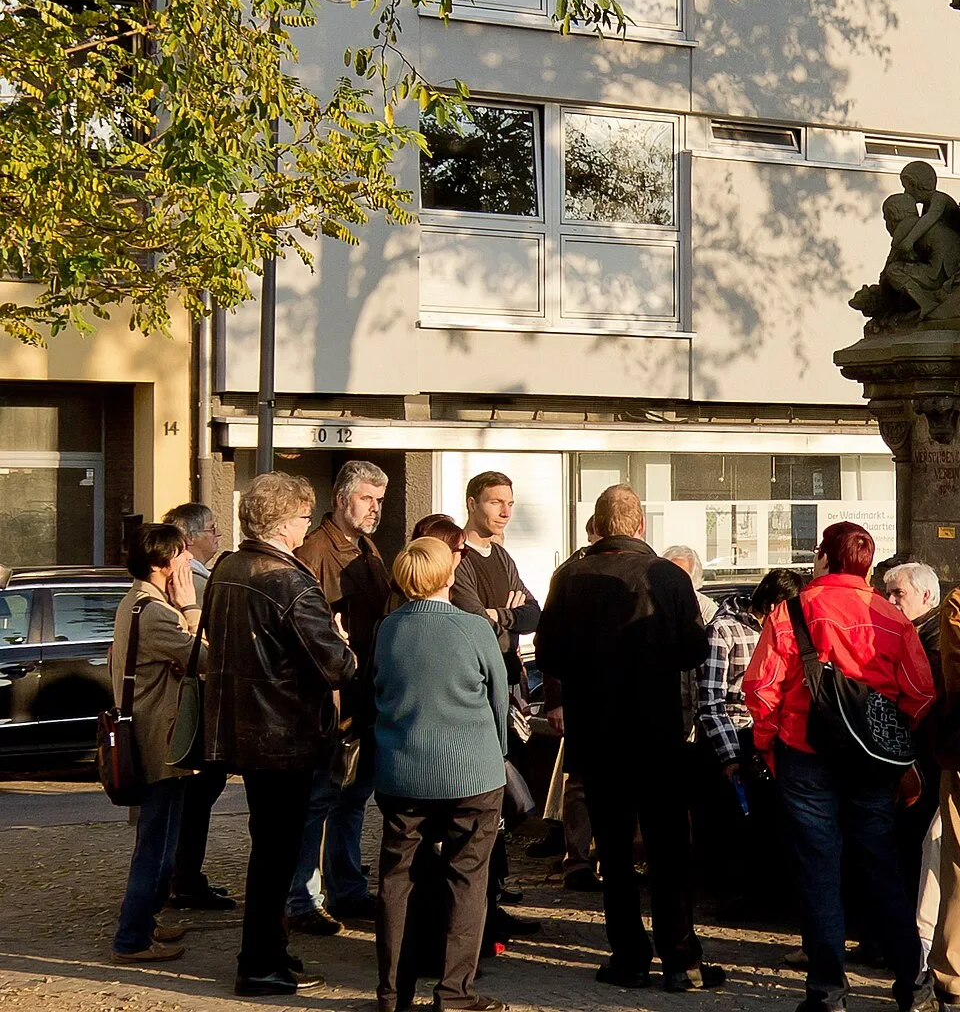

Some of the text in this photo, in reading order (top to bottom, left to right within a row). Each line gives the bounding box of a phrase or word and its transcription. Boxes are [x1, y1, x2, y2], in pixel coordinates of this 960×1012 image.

[163, 421, 180, 436] 14
[311, 428, 353, 443] 10 12
[840, 511, 885, 520] Waidmarkt
